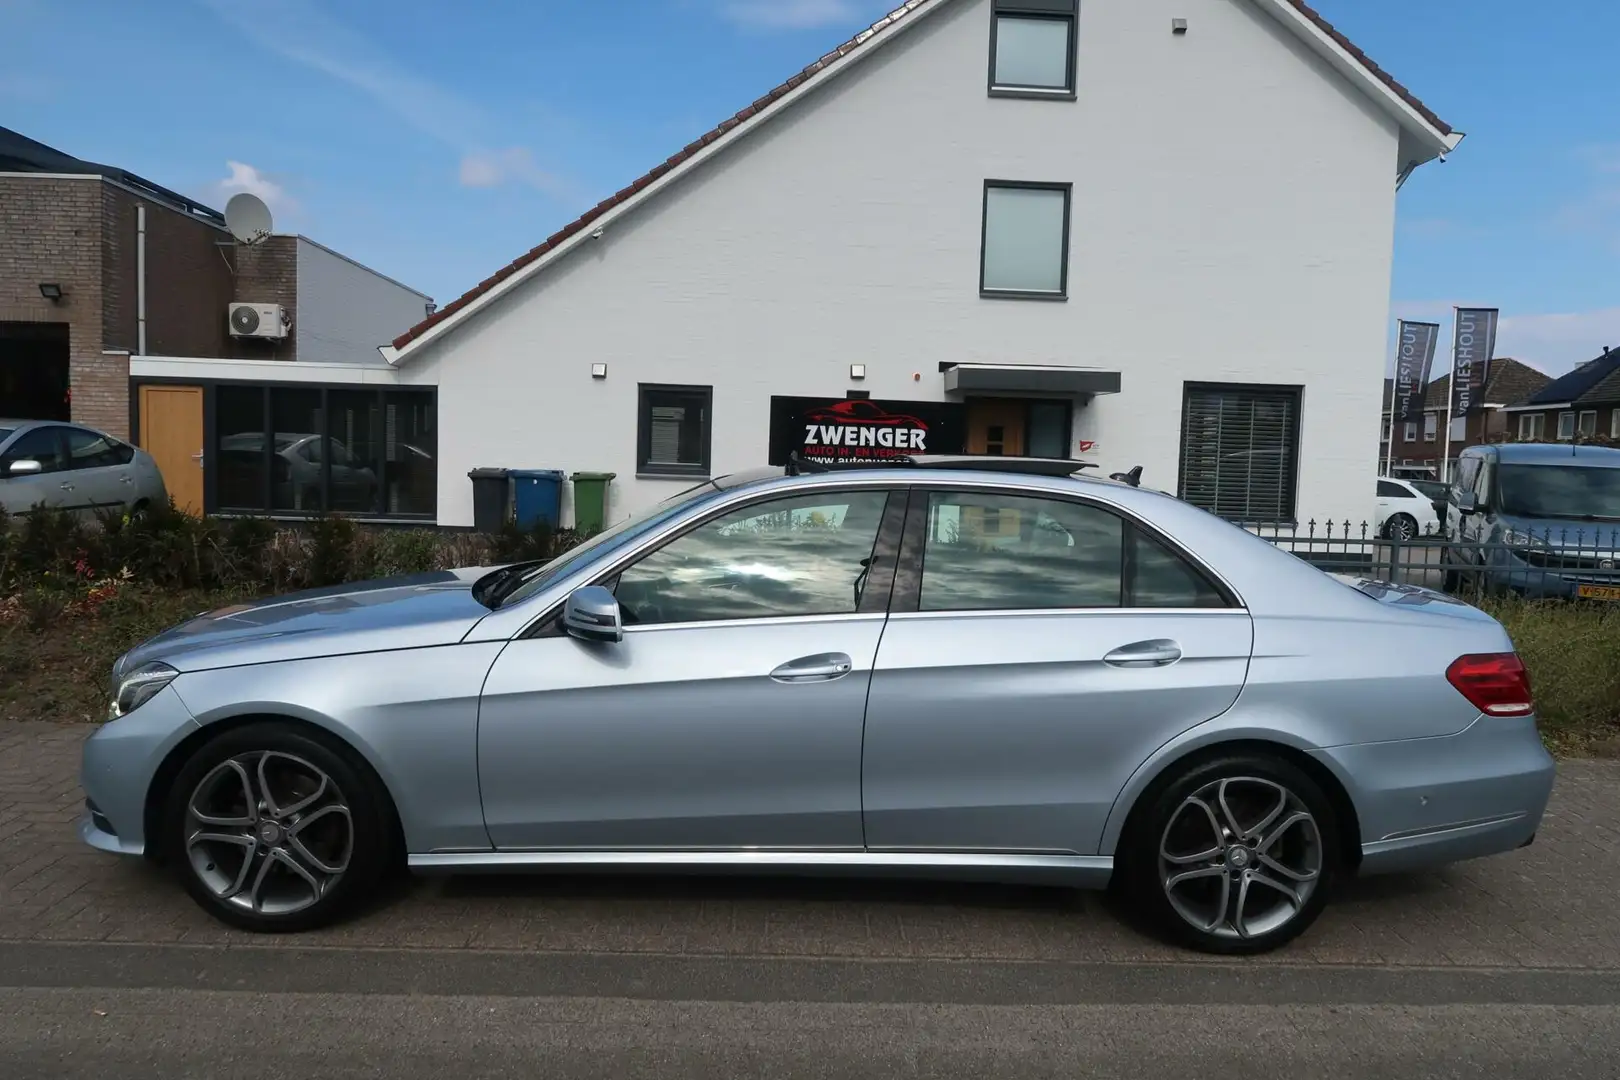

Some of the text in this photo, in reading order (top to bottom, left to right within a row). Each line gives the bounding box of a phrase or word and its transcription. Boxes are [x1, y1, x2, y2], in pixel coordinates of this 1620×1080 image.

[1456, 312, 1475, 415] vanLIESHOUT
[804, 424, 927, 450] ZWENGER
[804, 446, 834, 456] AUTO
[855, 448, 871, 457] EN
